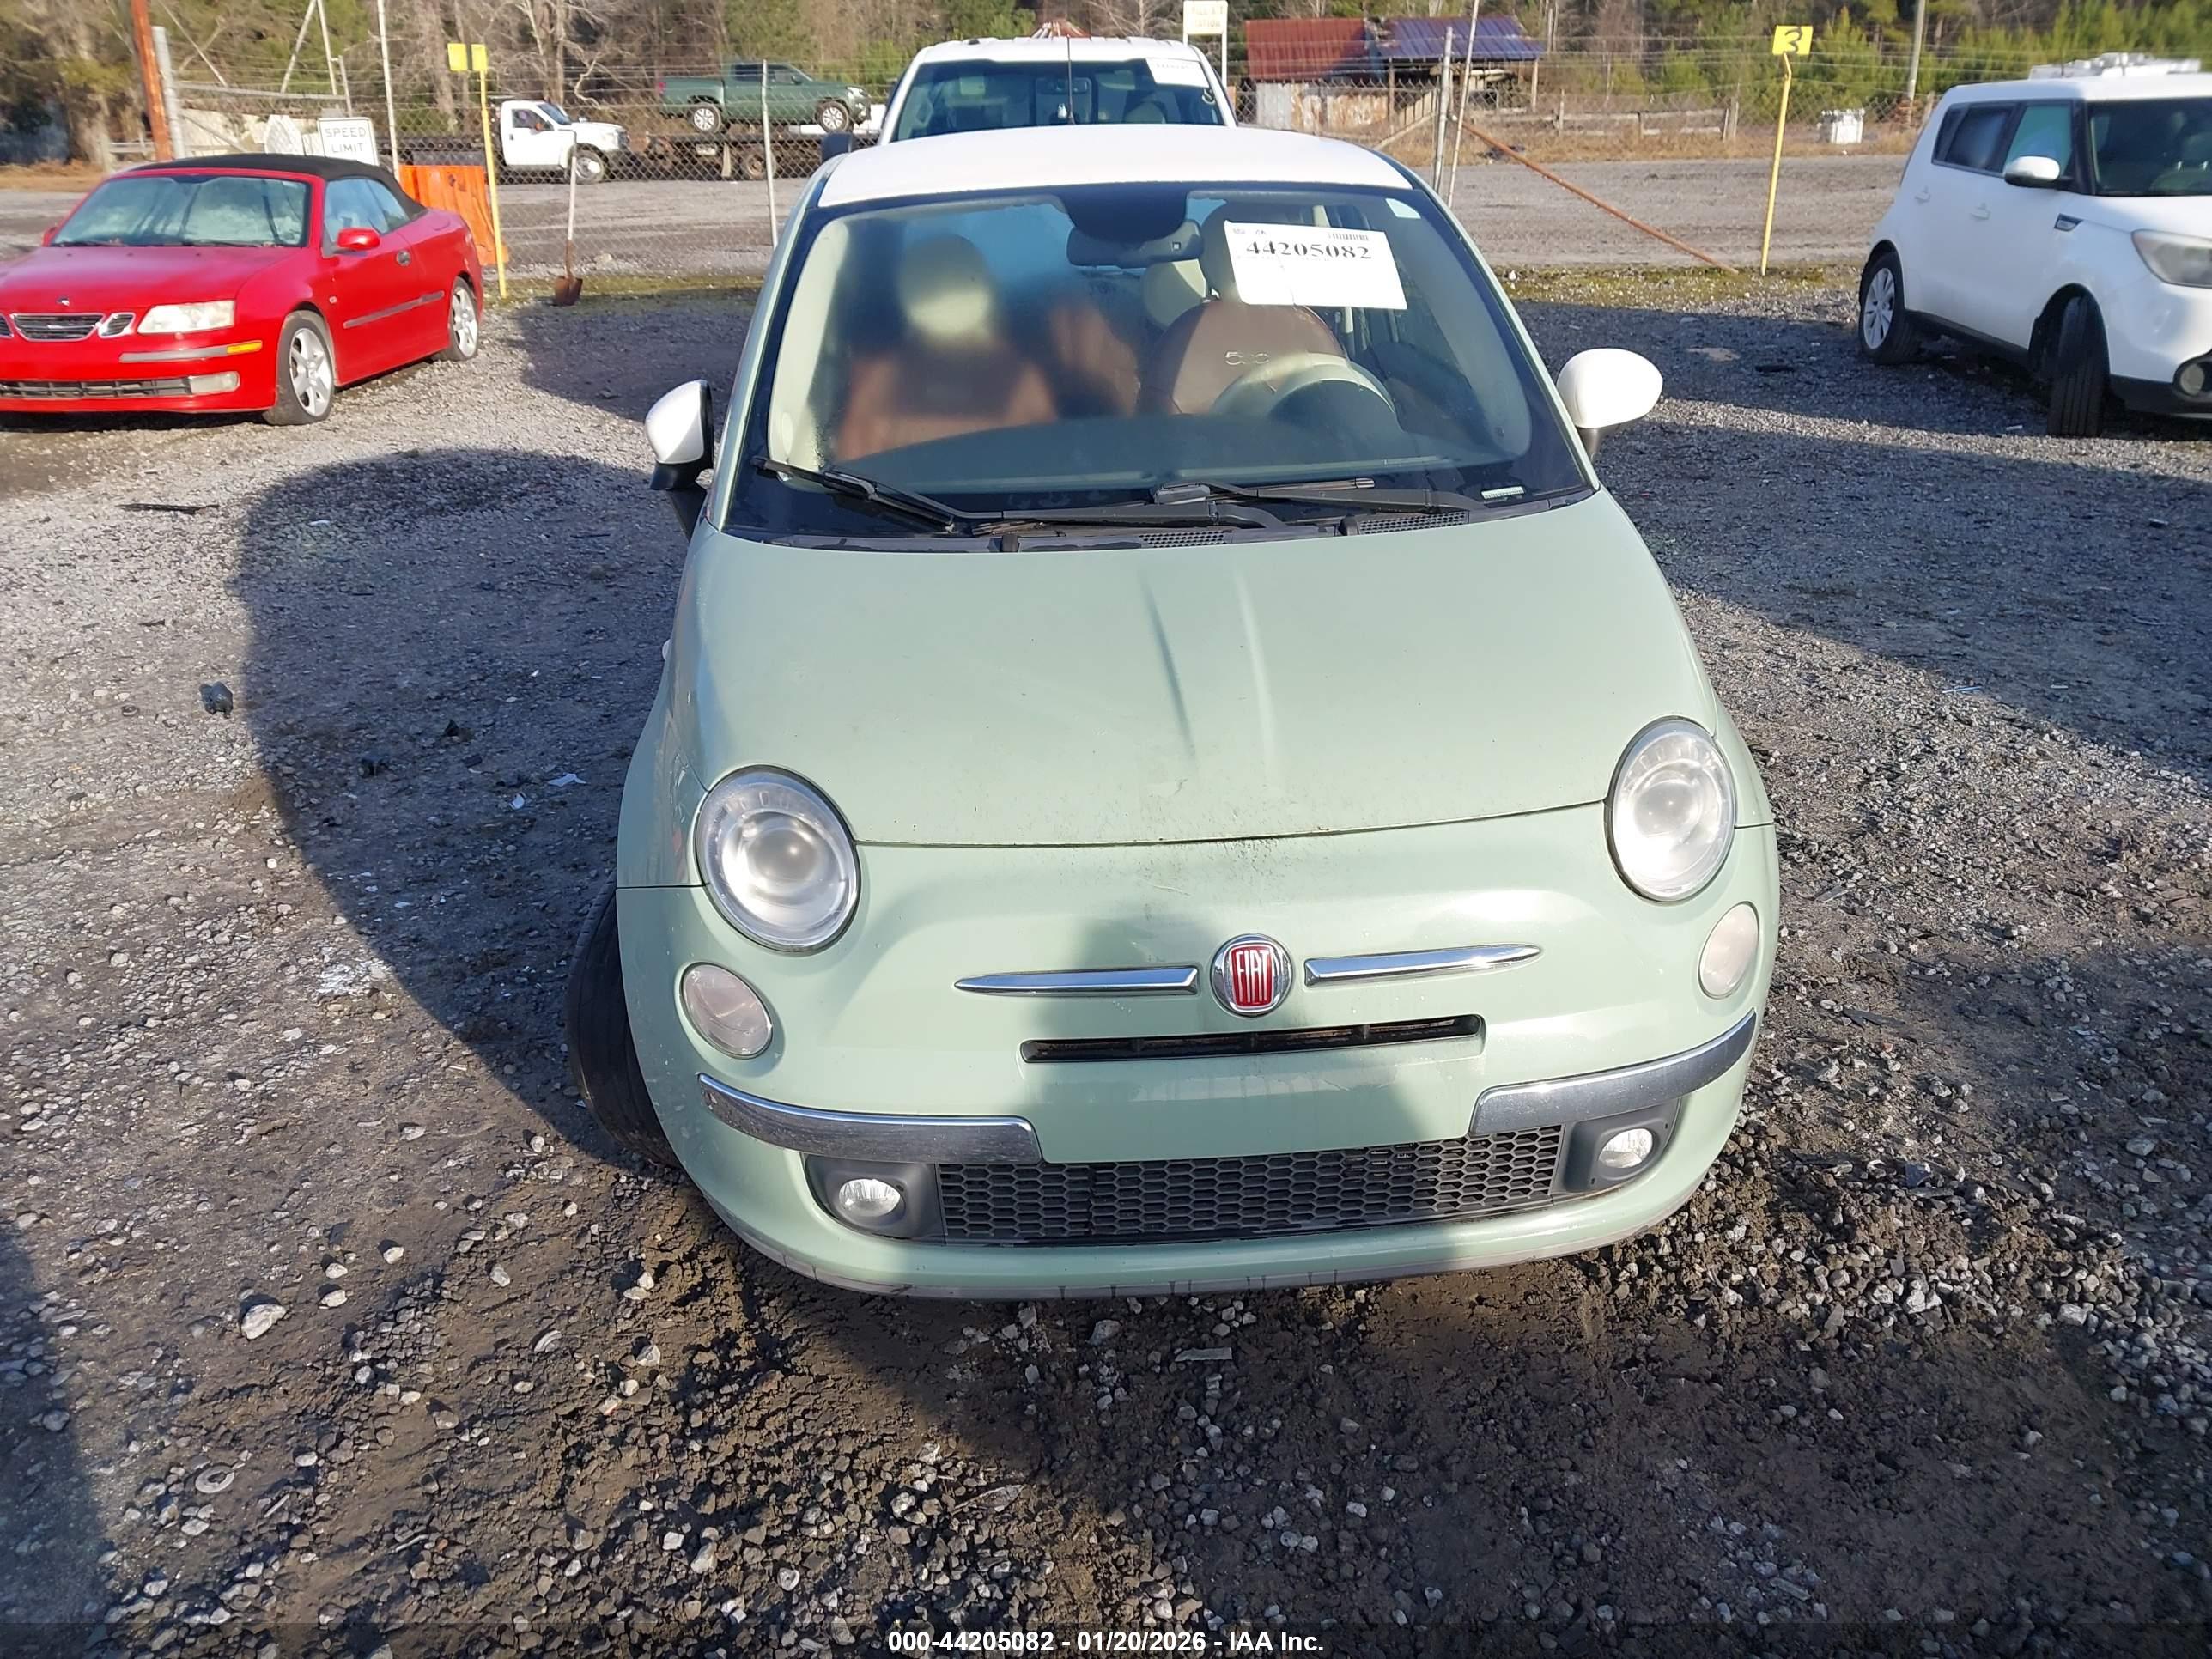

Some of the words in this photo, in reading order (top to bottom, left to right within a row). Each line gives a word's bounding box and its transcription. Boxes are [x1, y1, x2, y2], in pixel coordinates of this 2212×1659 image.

[1784, 27, 1802, 54] 3
[324, 126, 367, 137] SPEED
[331, 143, 364, 153] LIMIT
[1246, 240, 1372, 259] 44205082
[1235, 948, 1271, 1003] FIAT
